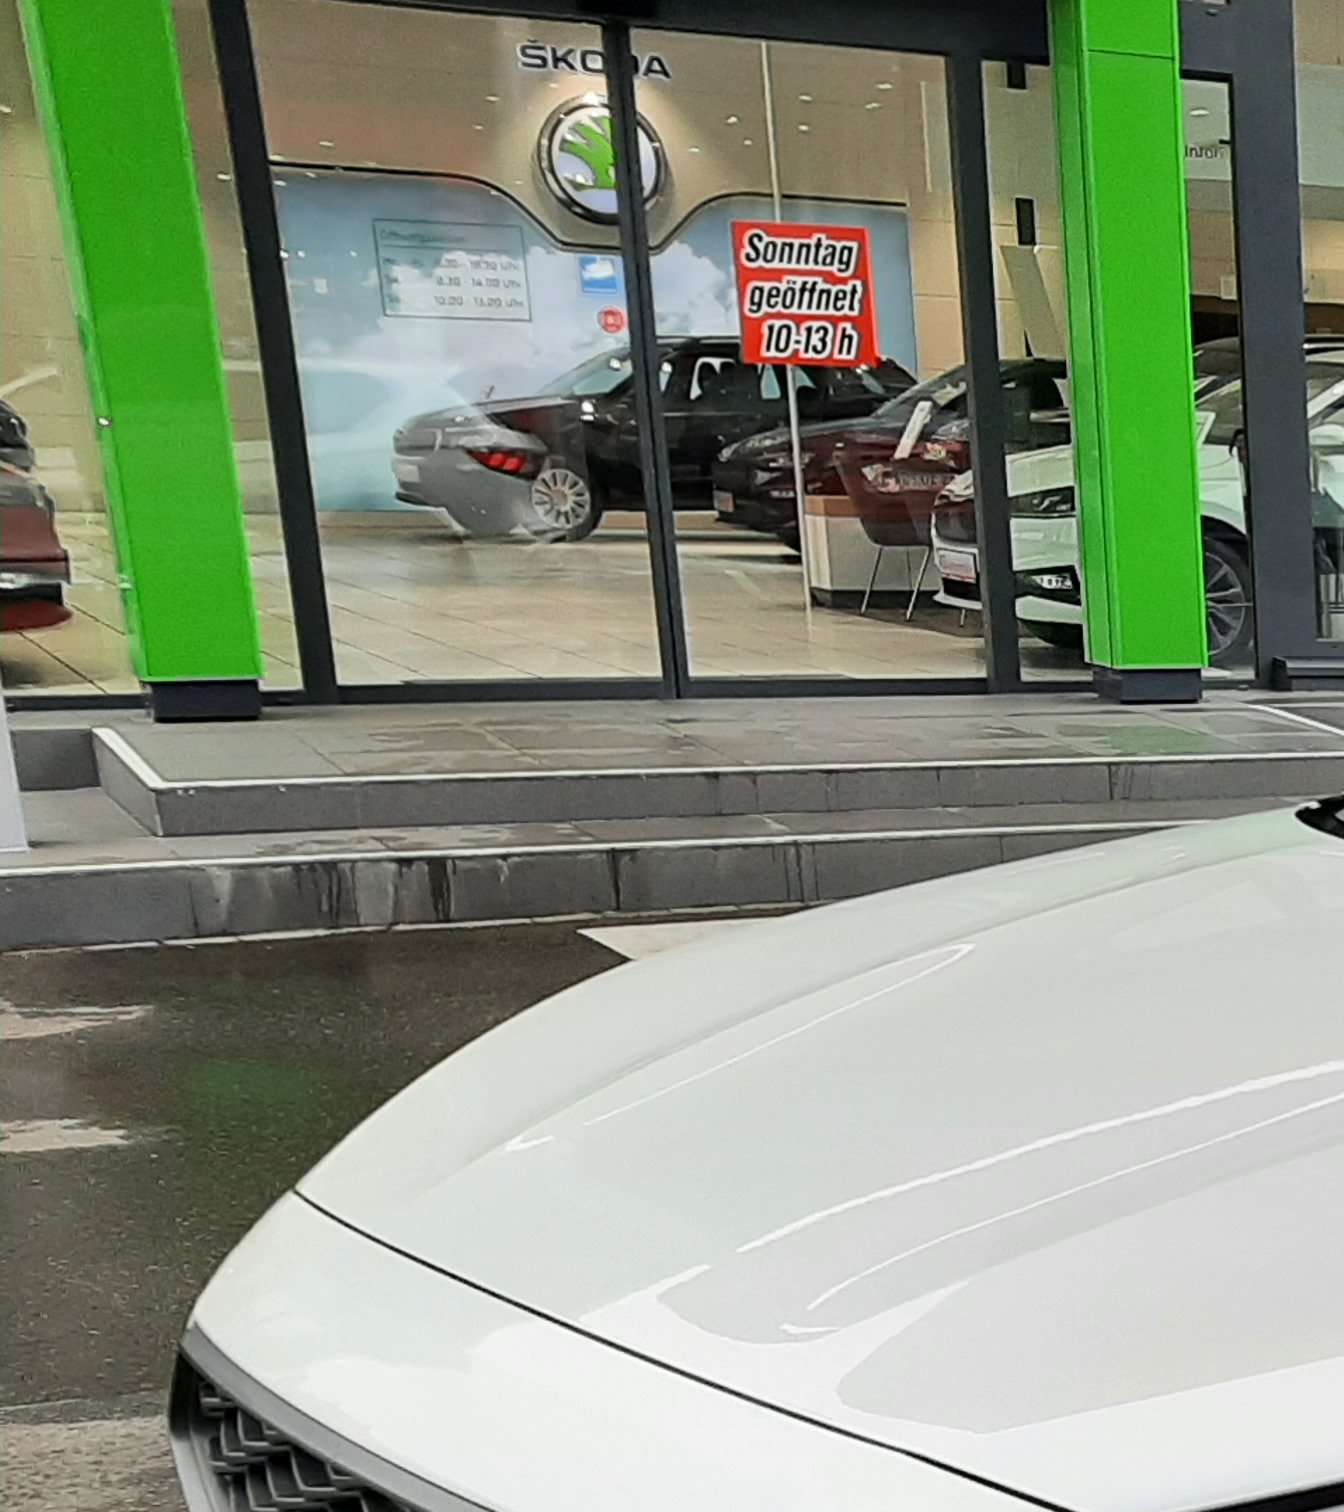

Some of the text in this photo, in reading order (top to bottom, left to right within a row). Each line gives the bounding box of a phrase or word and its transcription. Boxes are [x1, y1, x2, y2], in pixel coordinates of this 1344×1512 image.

[518, 39, 672, 79] ŠKOA
[744, 231, 855, 274] Sonntag
[747, 279, 859, 315] geöffnet
[765, 323, 855, 356] 10-13 h
